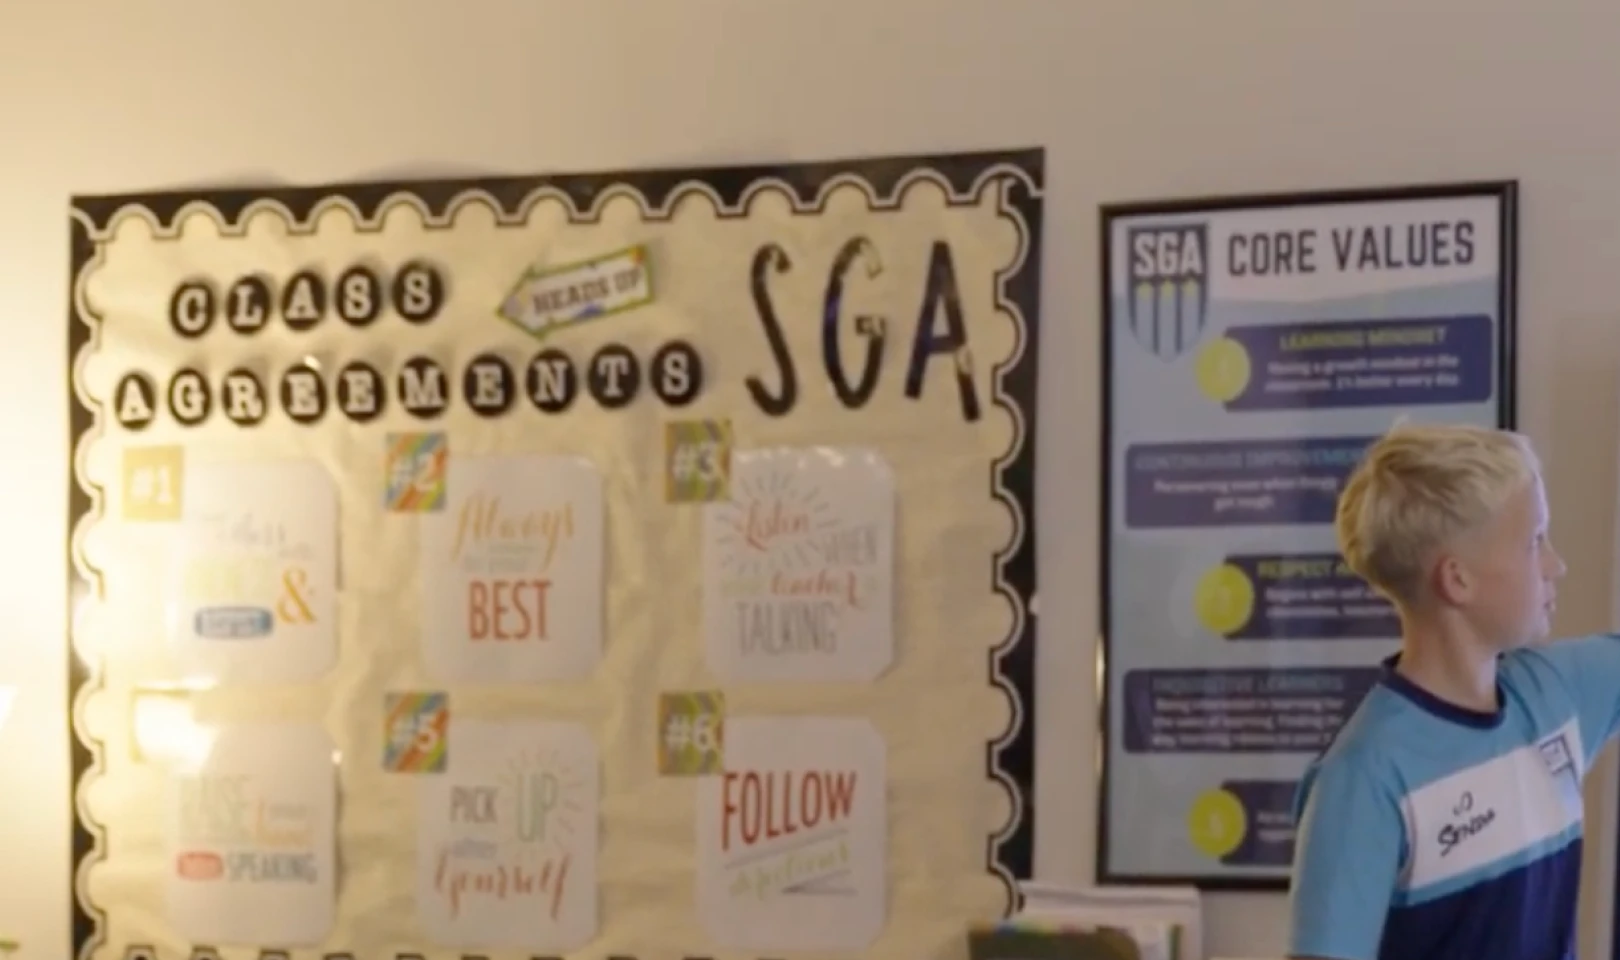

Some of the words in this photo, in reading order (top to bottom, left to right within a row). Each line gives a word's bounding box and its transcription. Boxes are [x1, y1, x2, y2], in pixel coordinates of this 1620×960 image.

[608, 267, 642, 296] UP
[1132, 230, 1204, 278] SGA
[1227, 230, 1318, 278] CORE
[1331, 220, 1476, 272] VALUES
[173, 265, 443, 334] CLASS
[744, 234, 982, 422] SGA
[118, 347, 694, 425] AGREEMENTS
[468, 578, 553, 641] BEST
[735, 600, 838, 656] TALKING
[450, 785, 498, 824] PICK
[517, 771, 560, 843] UP
[721, 770, 859, 852] FOLLOW
